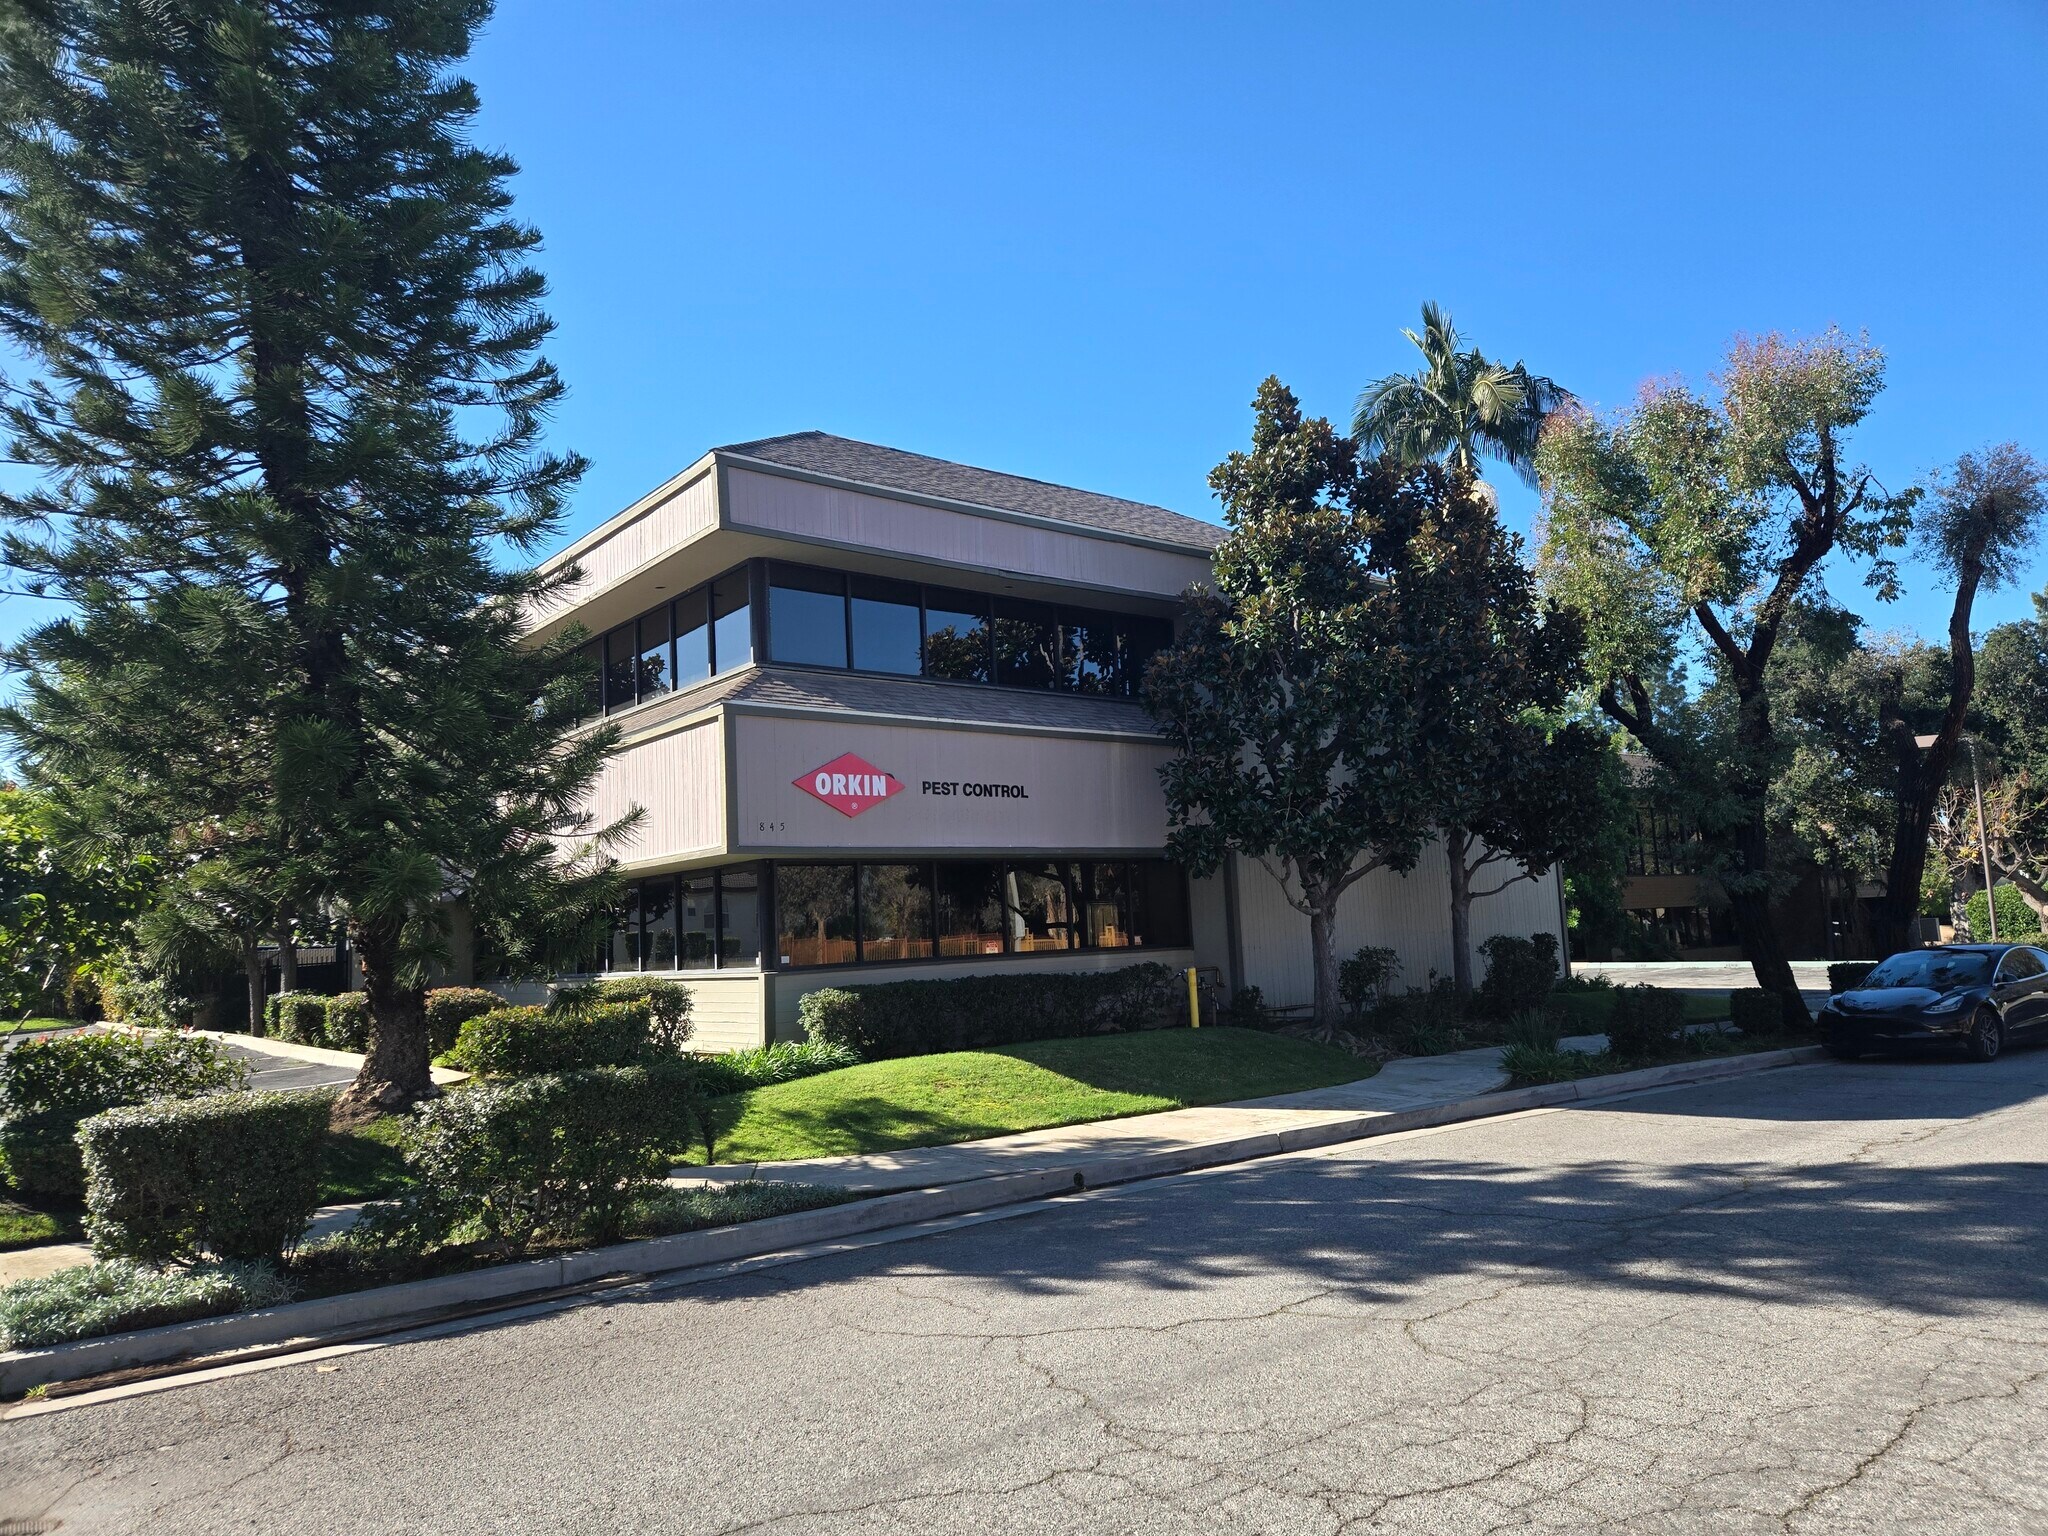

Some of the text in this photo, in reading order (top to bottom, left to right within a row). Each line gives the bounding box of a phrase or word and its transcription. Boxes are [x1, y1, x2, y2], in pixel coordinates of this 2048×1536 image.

[815, 772, 886, 796] ORKIN
[922, 781, 1029, 798] PEST CONTROL
